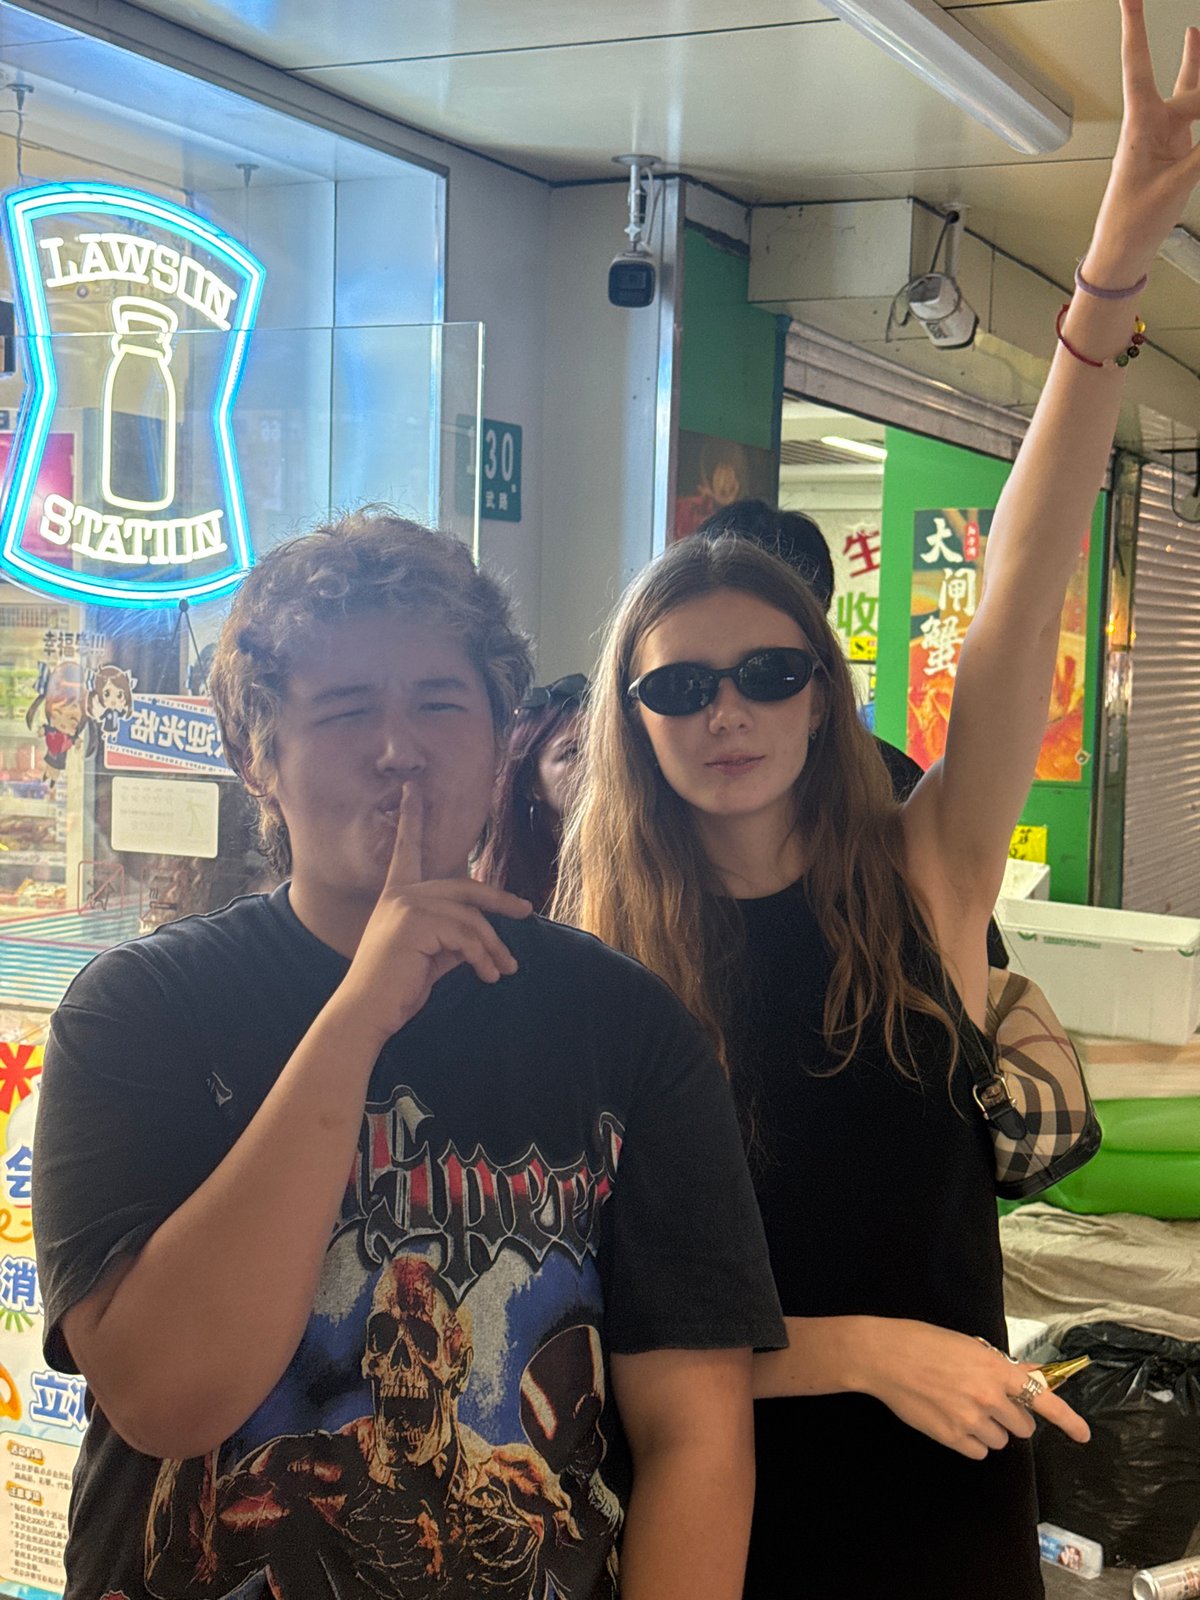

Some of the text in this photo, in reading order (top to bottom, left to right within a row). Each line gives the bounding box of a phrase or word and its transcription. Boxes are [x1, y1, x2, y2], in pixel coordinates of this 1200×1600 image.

[39, 233, 237, 331] LAWSON
[40, 494, 227, 565] STATION
[920, 518, 977, 678] 大闸蟹
